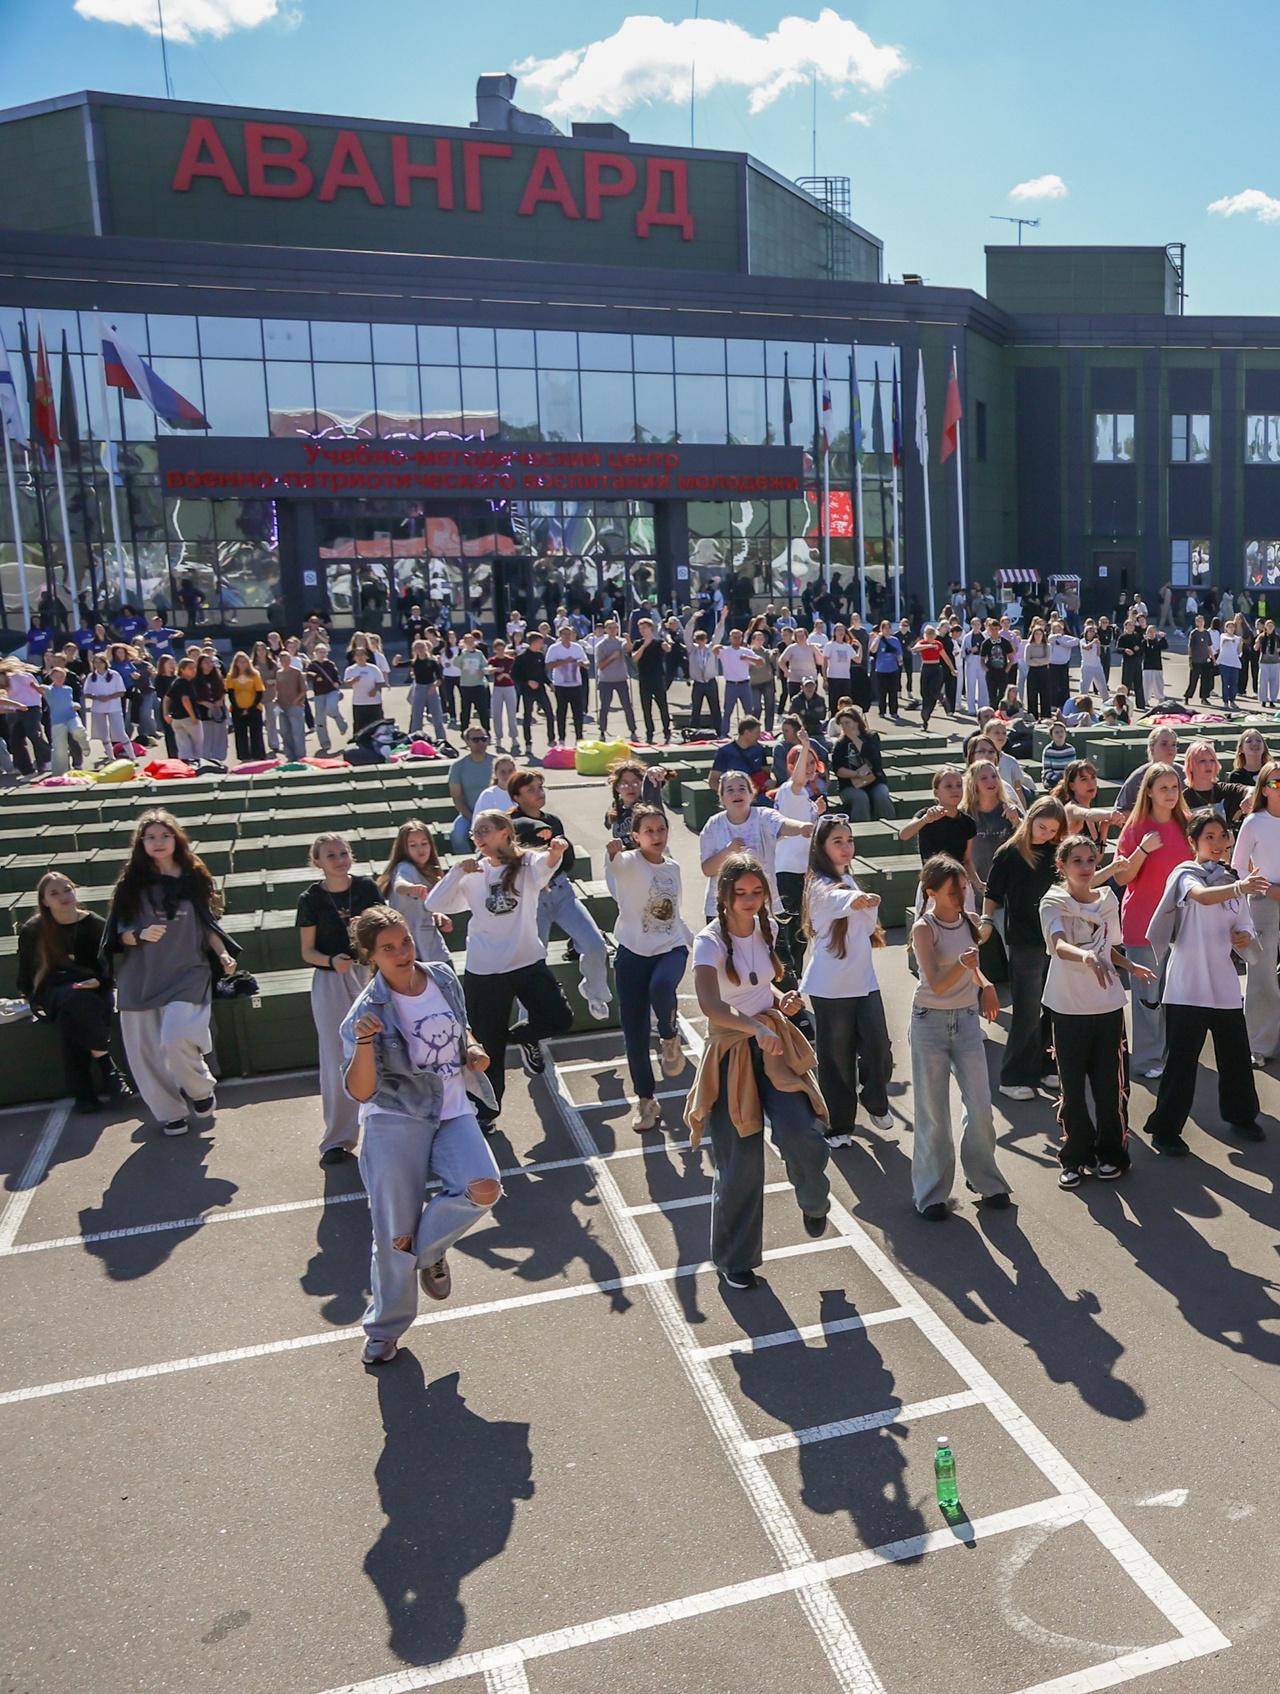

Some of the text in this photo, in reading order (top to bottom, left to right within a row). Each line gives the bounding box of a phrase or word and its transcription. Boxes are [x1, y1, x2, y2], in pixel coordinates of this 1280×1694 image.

[171, 117, 695, 241] АВАНГАРД
[303, 443, 680, 472] Учебно-методический центр
[166, 470, 800, 494] военно-патриотического воспитания молодежи
